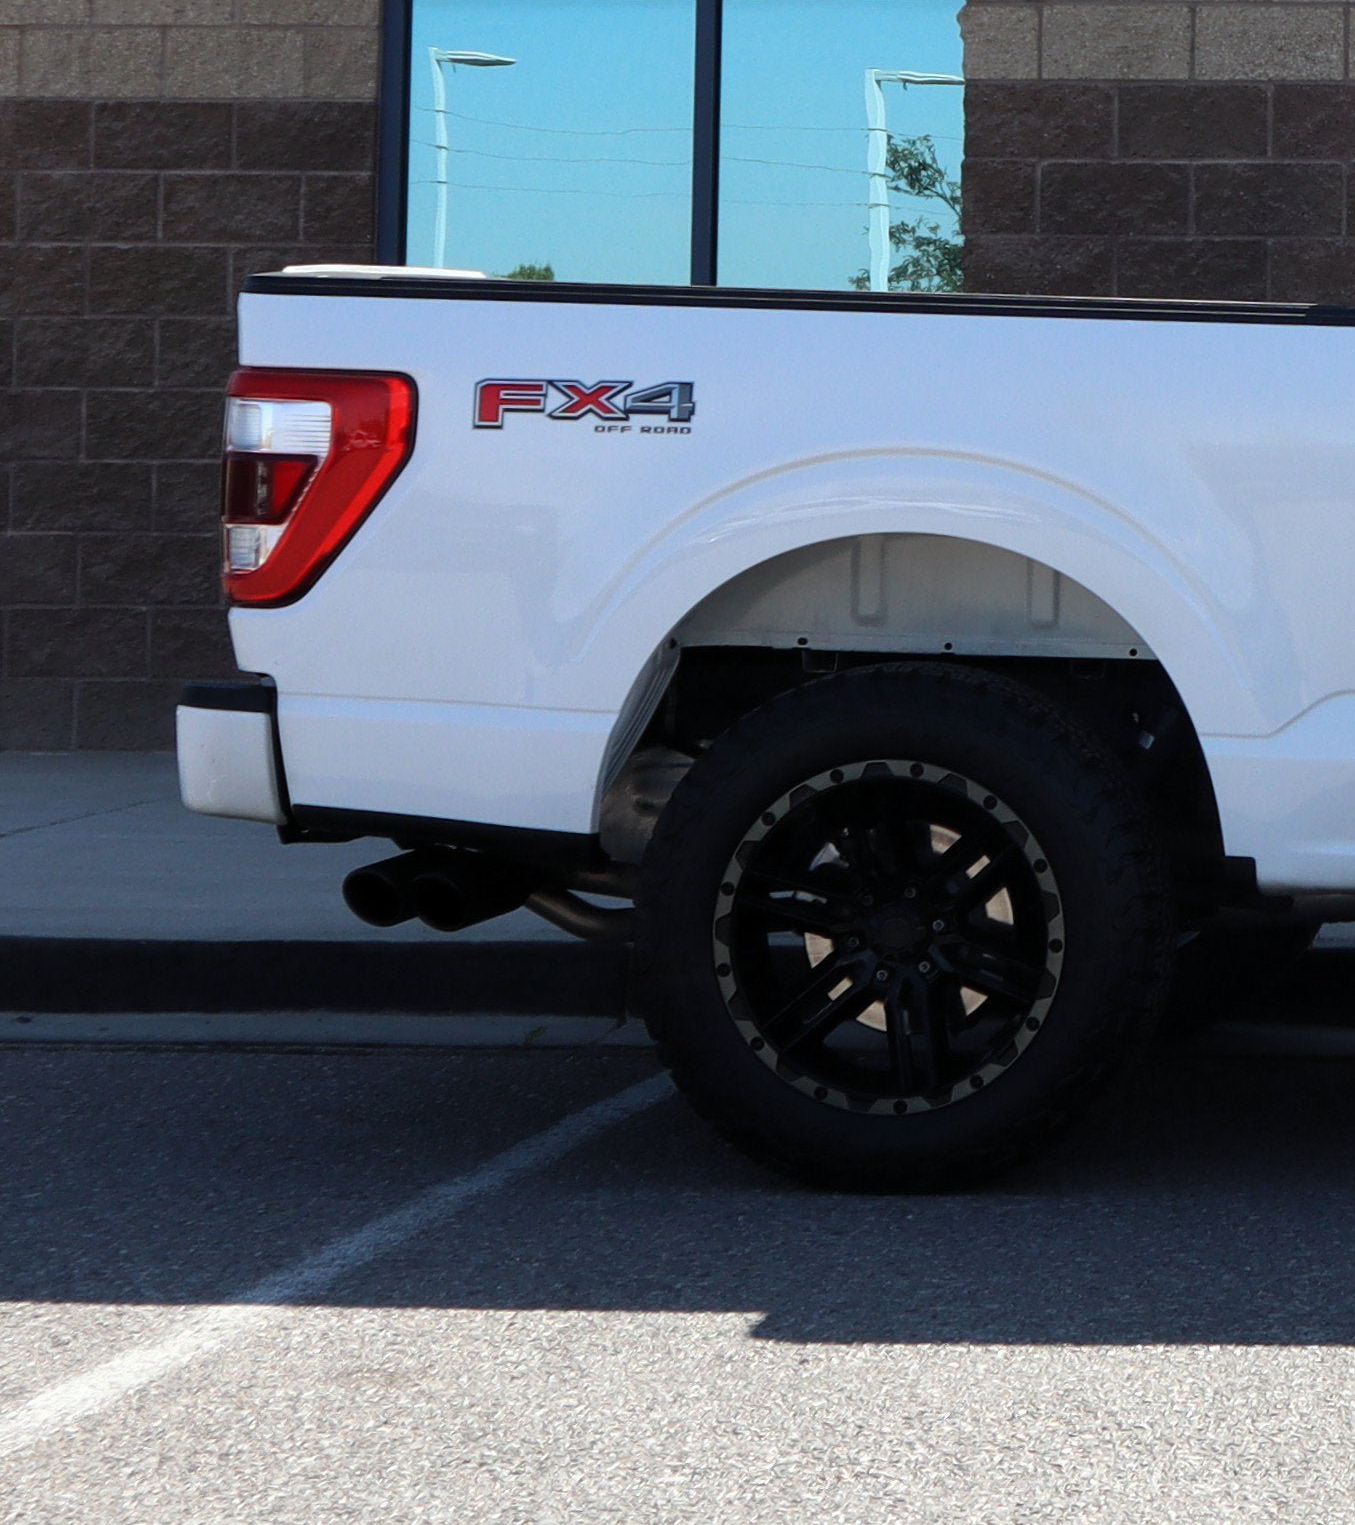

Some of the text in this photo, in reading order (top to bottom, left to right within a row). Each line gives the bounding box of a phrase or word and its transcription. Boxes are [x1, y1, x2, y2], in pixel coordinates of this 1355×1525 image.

[472, 378, 695, 429] FX4
[594, 425, 692, 435] OFF ROAD
